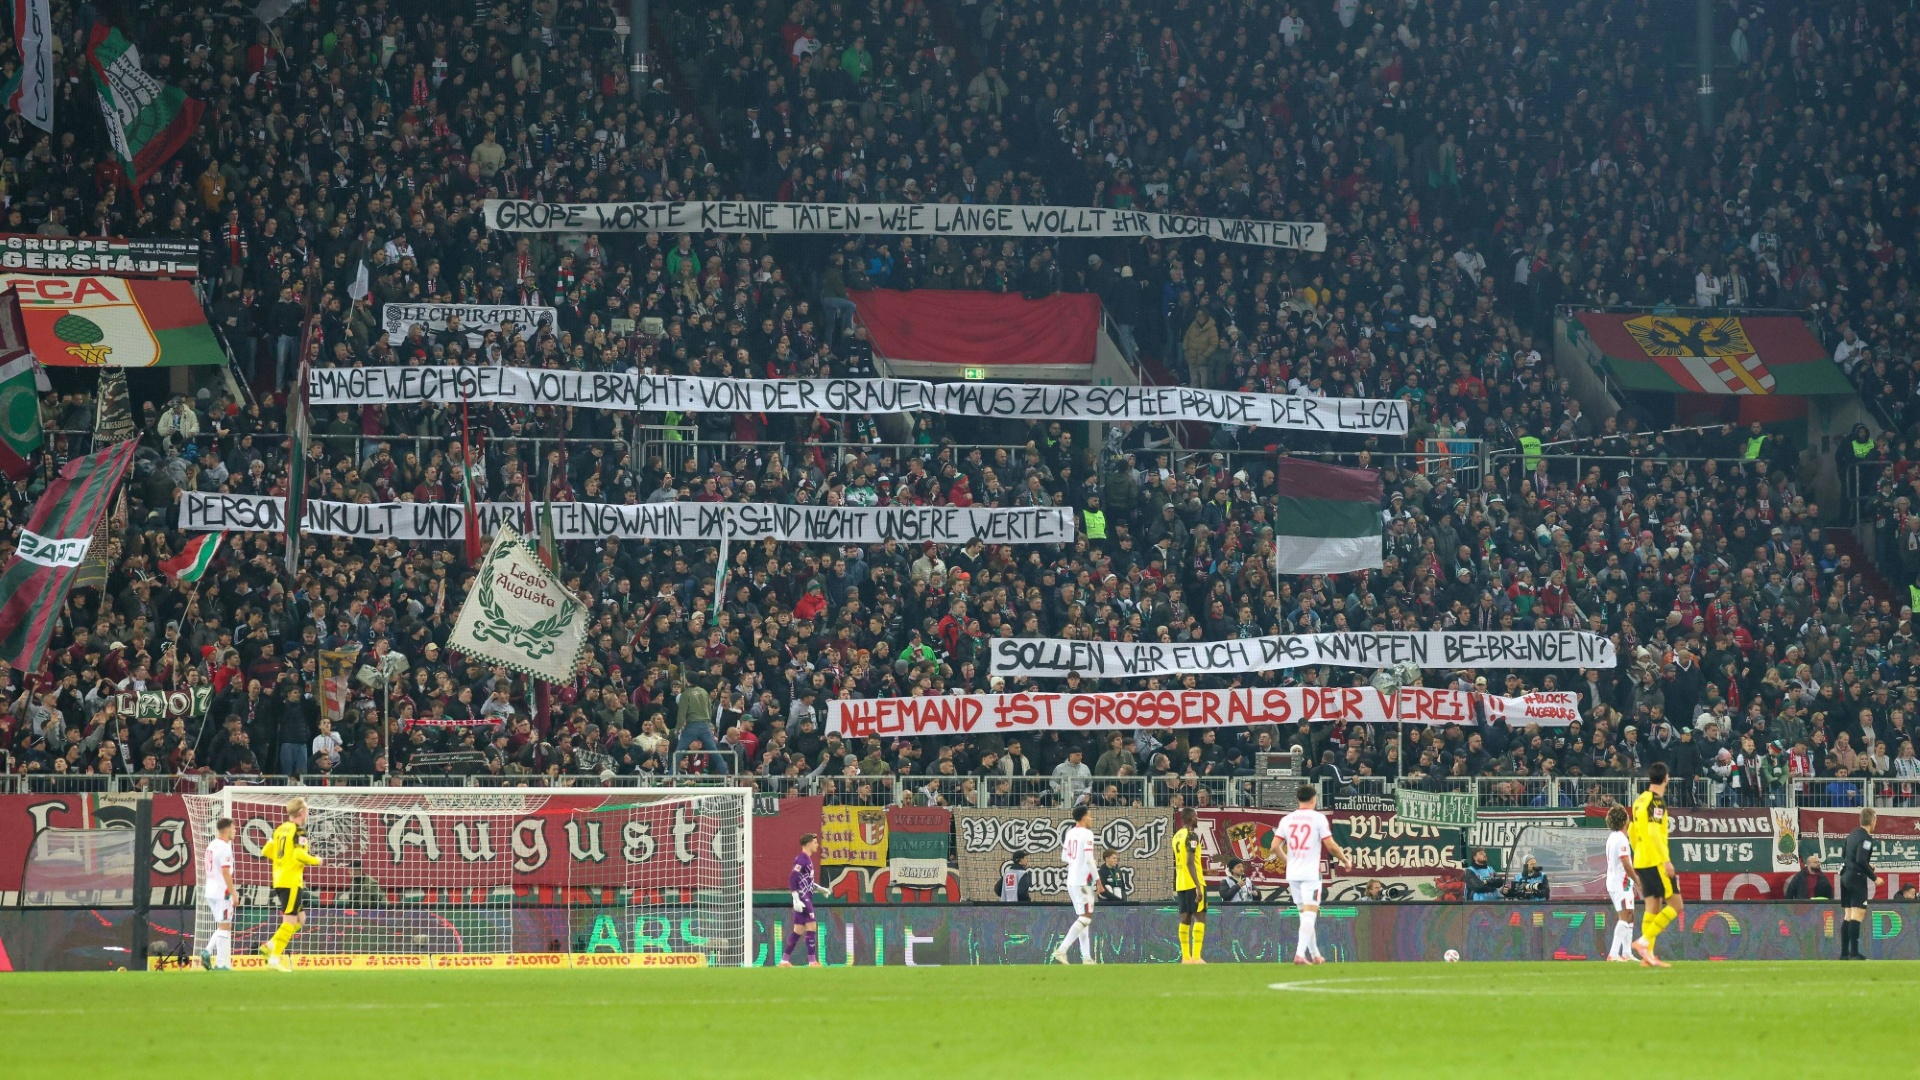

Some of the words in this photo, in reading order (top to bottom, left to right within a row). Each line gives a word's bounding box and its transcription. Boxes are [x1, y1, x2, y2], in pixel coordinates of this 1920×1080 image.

[596, 202, 686, 229] WORTE
[701, 202, 778, 229] KEINE
[935, 207, 1013, 232] LANGE
[1021, 208, 1106, 232] WOLLT
[1112, 211, 1150, 232] IHR
[1159, 214, 1210, 235] NOCH
[1218, 218, 1315, 248] WARTEN?
[7, 237, 110, 251] GRUPPE
[6, 277, 120, 303] FCA
[403, 307, 538, 327] LECHPIRATEN
[527, 370, 695, 406] VOLLBRACHT:
[700, 379, 751, 410] VON
[763, 380, 819, 410] DER
[826, 381, 937, 410] GRAUEN
[945, 384, 1016, 415] MAUS
[1020, 388, 1079, 416] ZUR
[1271, 396, 1324, 429] DER
[1338, 400, 1404, 431] LIGA
[188, 495, 401, 535] PERSONNKULT
[414, 504, 462, 538] UND
[805, 508, 864, 539] NICHT
[876, 508, 960, 540] UNSERE
[968, 508, 1064, 539] WERTE!
[509, 562, 547, 588] Legio
[496, 572, 556, 607] Augusta
[997, 640, 1105, 674] SOLLEN
[1114, 645, 1167, 674] WIR
[1173, 643, 1250, 670] EUCH
[1259, 636, 1309, 664] DAS
[1444, 631, 1608, 663] BEIBRINGEN?
[840, 698, 982, 737] NIEMAND
[994, 694, 1061, 727] IST
[1067, 691, 1223, 727] GRÖSSER
[1228, 689, 1291, 724] ALS
[1302, 687, 1363, 720] DER
[100, 795, 136, 804] Augusta
[894, 815, 942, 825] WEITER
[1667, 815, 1772, 834] BURNING
[1288, 824, 1311, 850] 32
[1066, 840, 1079, 860] 40
[1682, 842, 1754, 862] NUTS
[314, 956, 353, 966] LOTTO
[382, 956, 421, 966] LOTTO
[455, 956, 493, 966] LOTTO
[521, 954, 560, 965] LOTTO
[591, 955, 630, 966] LOTTO
[659, 955, 697, 965] LOTTO
